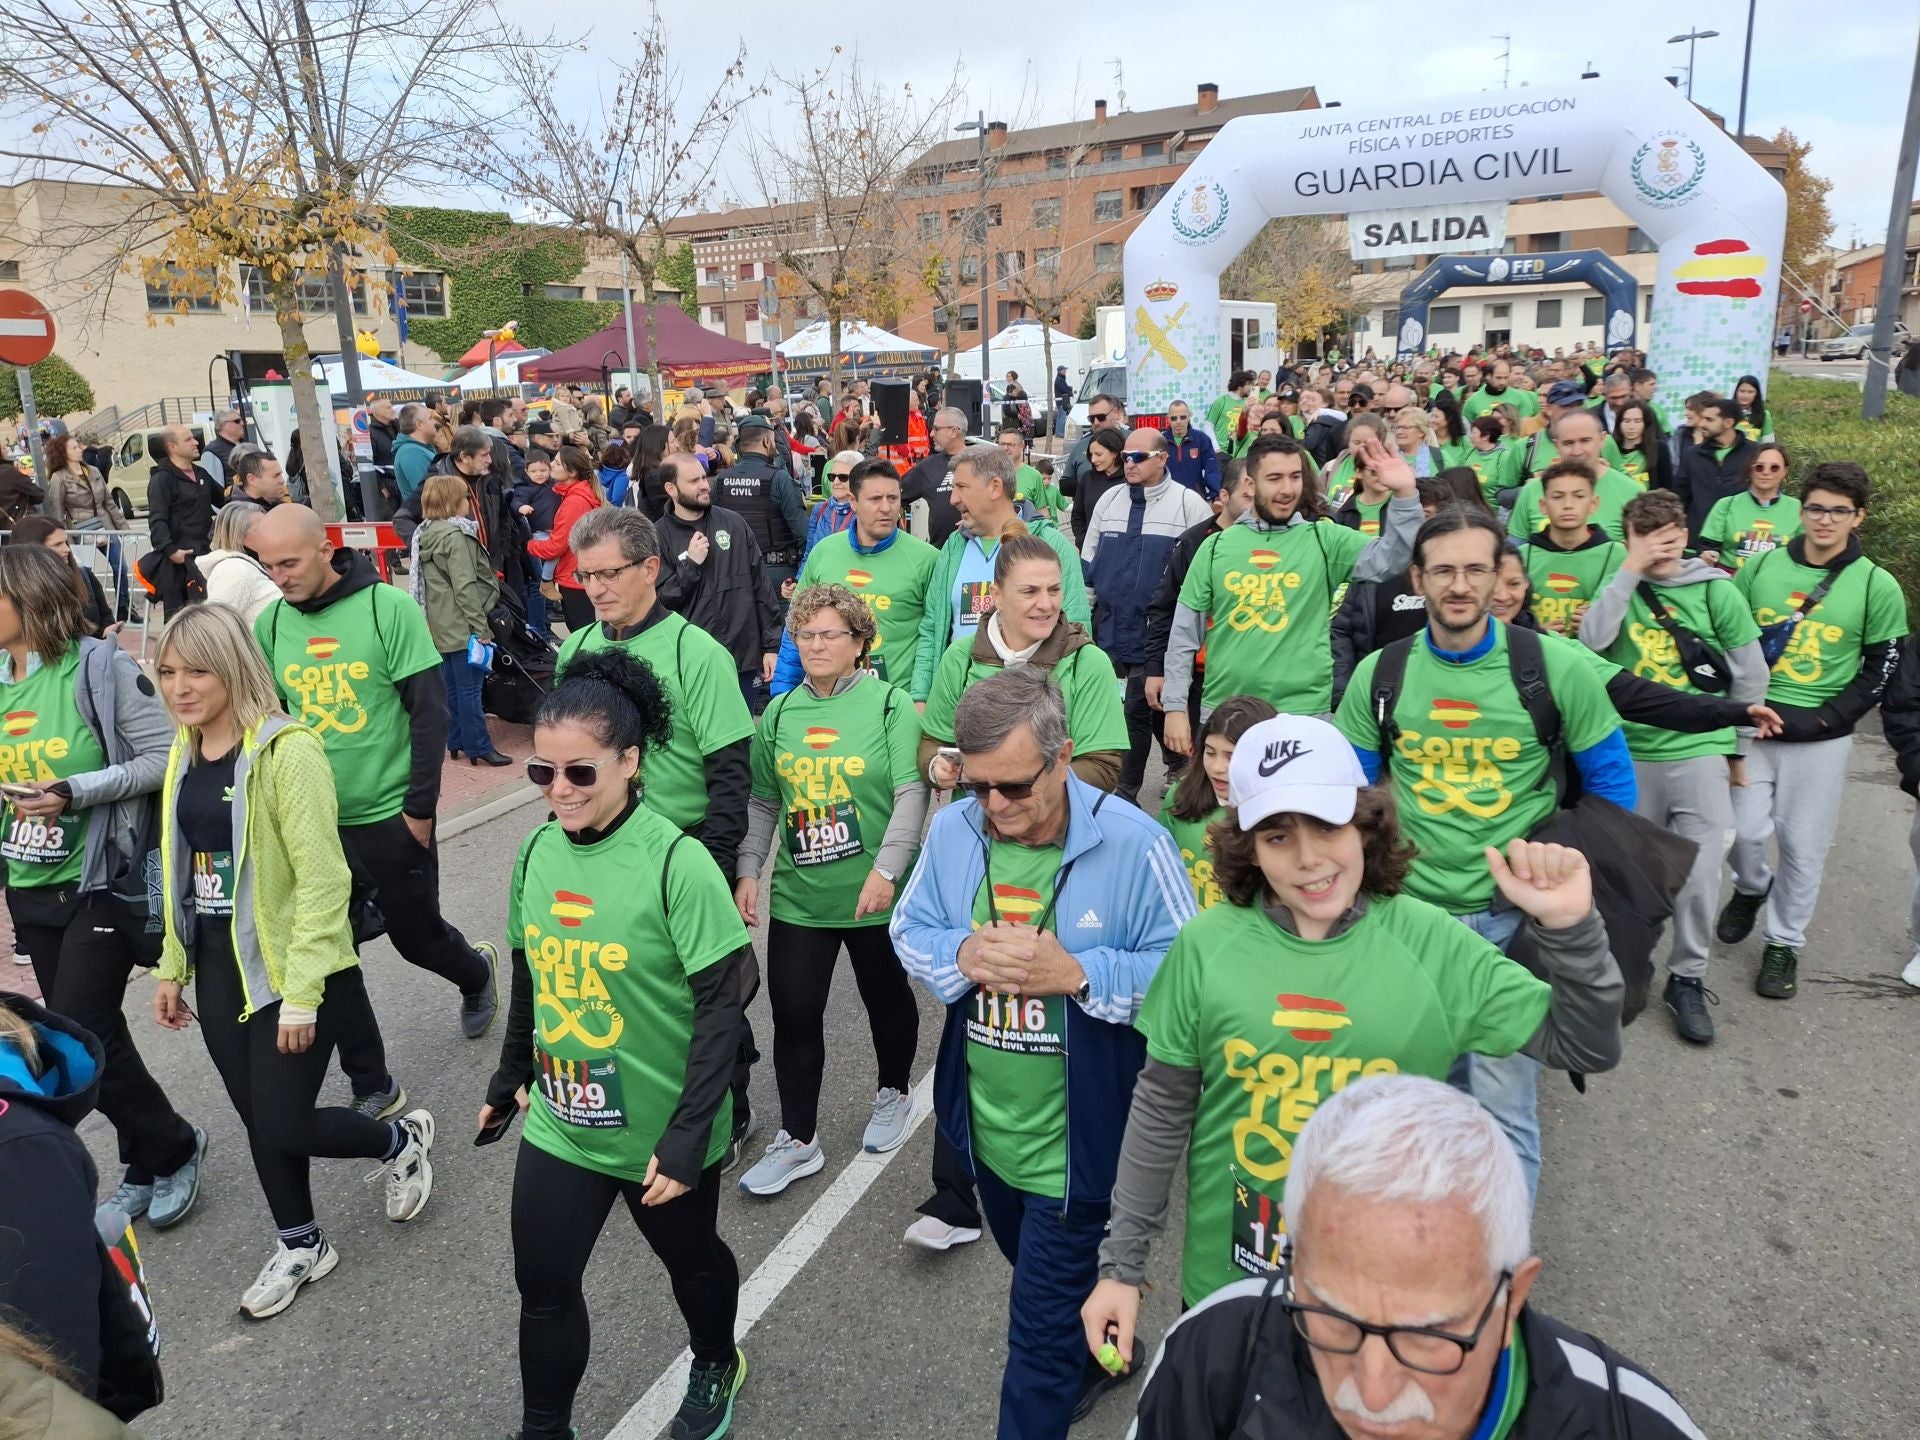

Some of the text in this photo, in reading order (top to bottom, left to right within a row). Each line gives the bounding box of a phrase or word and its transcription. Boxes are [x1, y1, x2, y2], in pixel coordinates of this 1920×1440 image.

[1299, 97, 1577, 140] JUNTA CENTRAL DE EDUCACIÓN
[1349, 124, 1514, 155] FÍSICA Y DEPORTES
[1295, 147, 1573, 197] GUARDIA CIVIL
[1363, 215, 1490, 247] SALIDA
[1511, 259, 1546, 274] FFD
[876, 351, 924, 365] GUARDIA CIVIL
[379, 388, 422, 401] GUARDIA
[462, 388, 496, 401] UARDIA
[724, 478, 760, 486] GUARDIA
[730, 488, 752, 496] CIVIL
[1224, 571, 1301, 593] Corre
[972, 595, 992, 613] 38
[1234, 586, 1286, 606] TEA
[1628, 622, 1672, 648] Cor
[284, 661, 370, 687] Corre
[296, 679, 357, 705] TEA
[0, 737, 69, 764] orre
[1264, 740, 1302, 762] NIKE
[1395, 730, 1522, 760] Corre
[776, 752, 866, 777] Corre
[1413, 757, 1504, 783] TEA
[787, 774, 852, 800] TEA
[10, 819, 64, 849] 1093
[796, 821, 850, 851] 1290
[822, 840, 861, 856] SOLIDARIA
[822, 853, 840, 862] CIVIL
[194, 872, 225, 898] 1092
[1077, 920, 1103, 928] adidas
[525, 924, 629, 971] Corre
[534, 959, 611, 1001] TEA
[574, 1001, 622, 1022] AUTISMO
[976, 991, 1046, 1031] 1116
[969, 1031, 1000, 1047] GUARDIA
[1002, 1041, 1026, 1051] CIVIL
[970, 1020, 1060, 1043] CARRERA SOLIDARIA
[542, 1072, 606, 1109] 1129
[570, 1108, 622, 1118] SOLIDARIA
[1243, 1081, 1319, 1134] TE
[570, 1117, 591, 1125] CIVIL
[1240, 1247, 1280, 1271] CARRE
